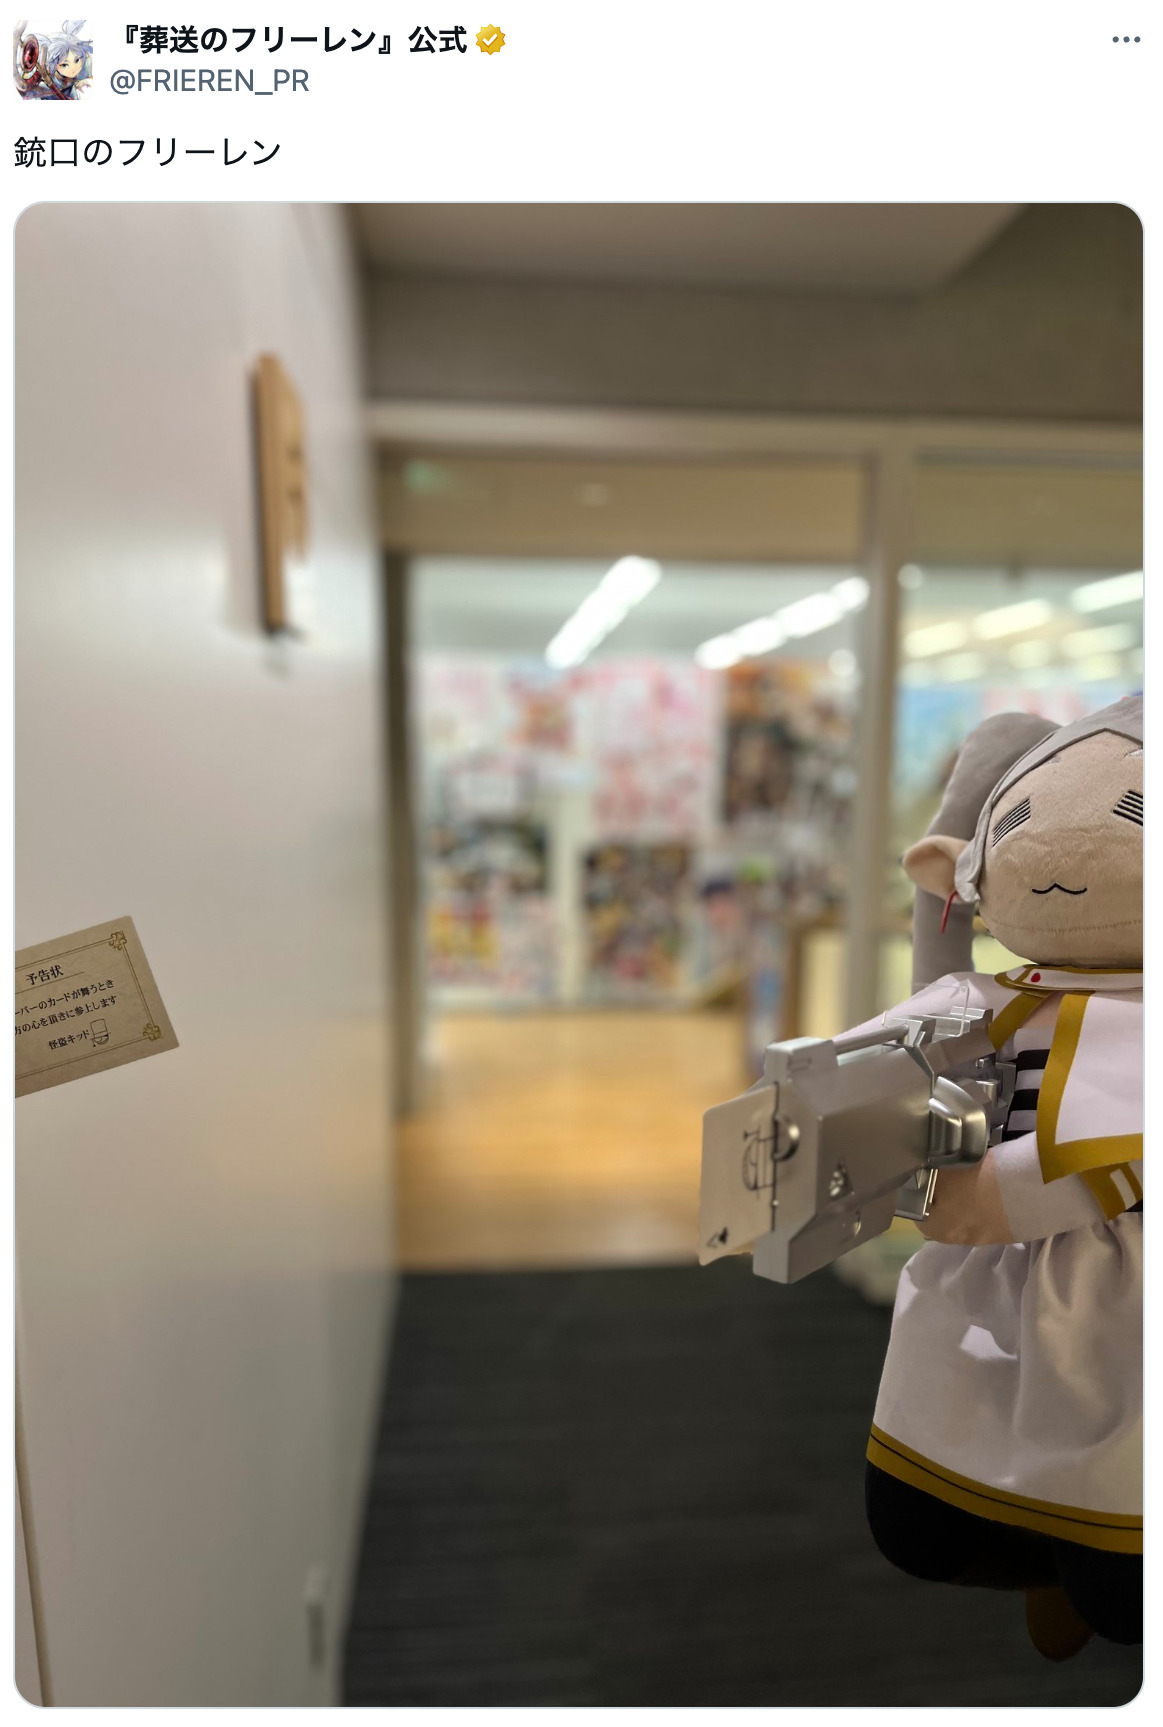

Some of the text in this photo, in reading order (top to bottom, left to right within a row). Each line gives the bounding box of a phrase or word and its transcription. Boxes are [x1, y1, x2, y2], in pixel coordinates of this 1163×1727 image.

[26, 965, 64, 985] 予告状
[48, 1030, 90, 1050] 怪盗キッド
